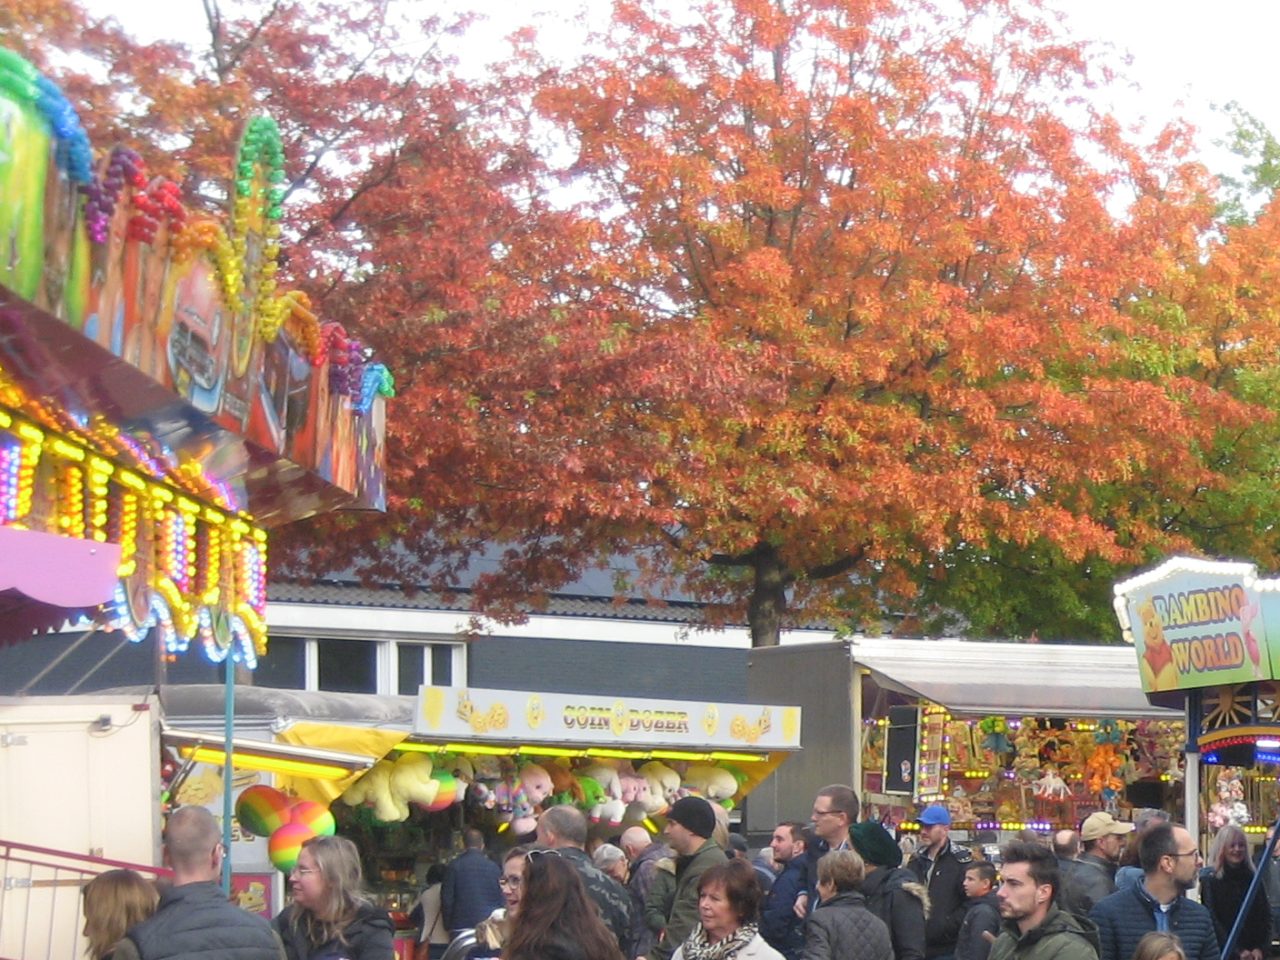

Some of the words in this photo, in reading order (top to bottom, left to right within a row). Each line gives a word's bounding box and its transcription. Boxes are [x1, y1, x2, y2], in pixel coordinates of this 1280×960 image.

[1152, 583, 1244, 630] BAMBINO
[1170, 632, 1244, 675] WORLD
[563, 704, 611, 730] COIN
